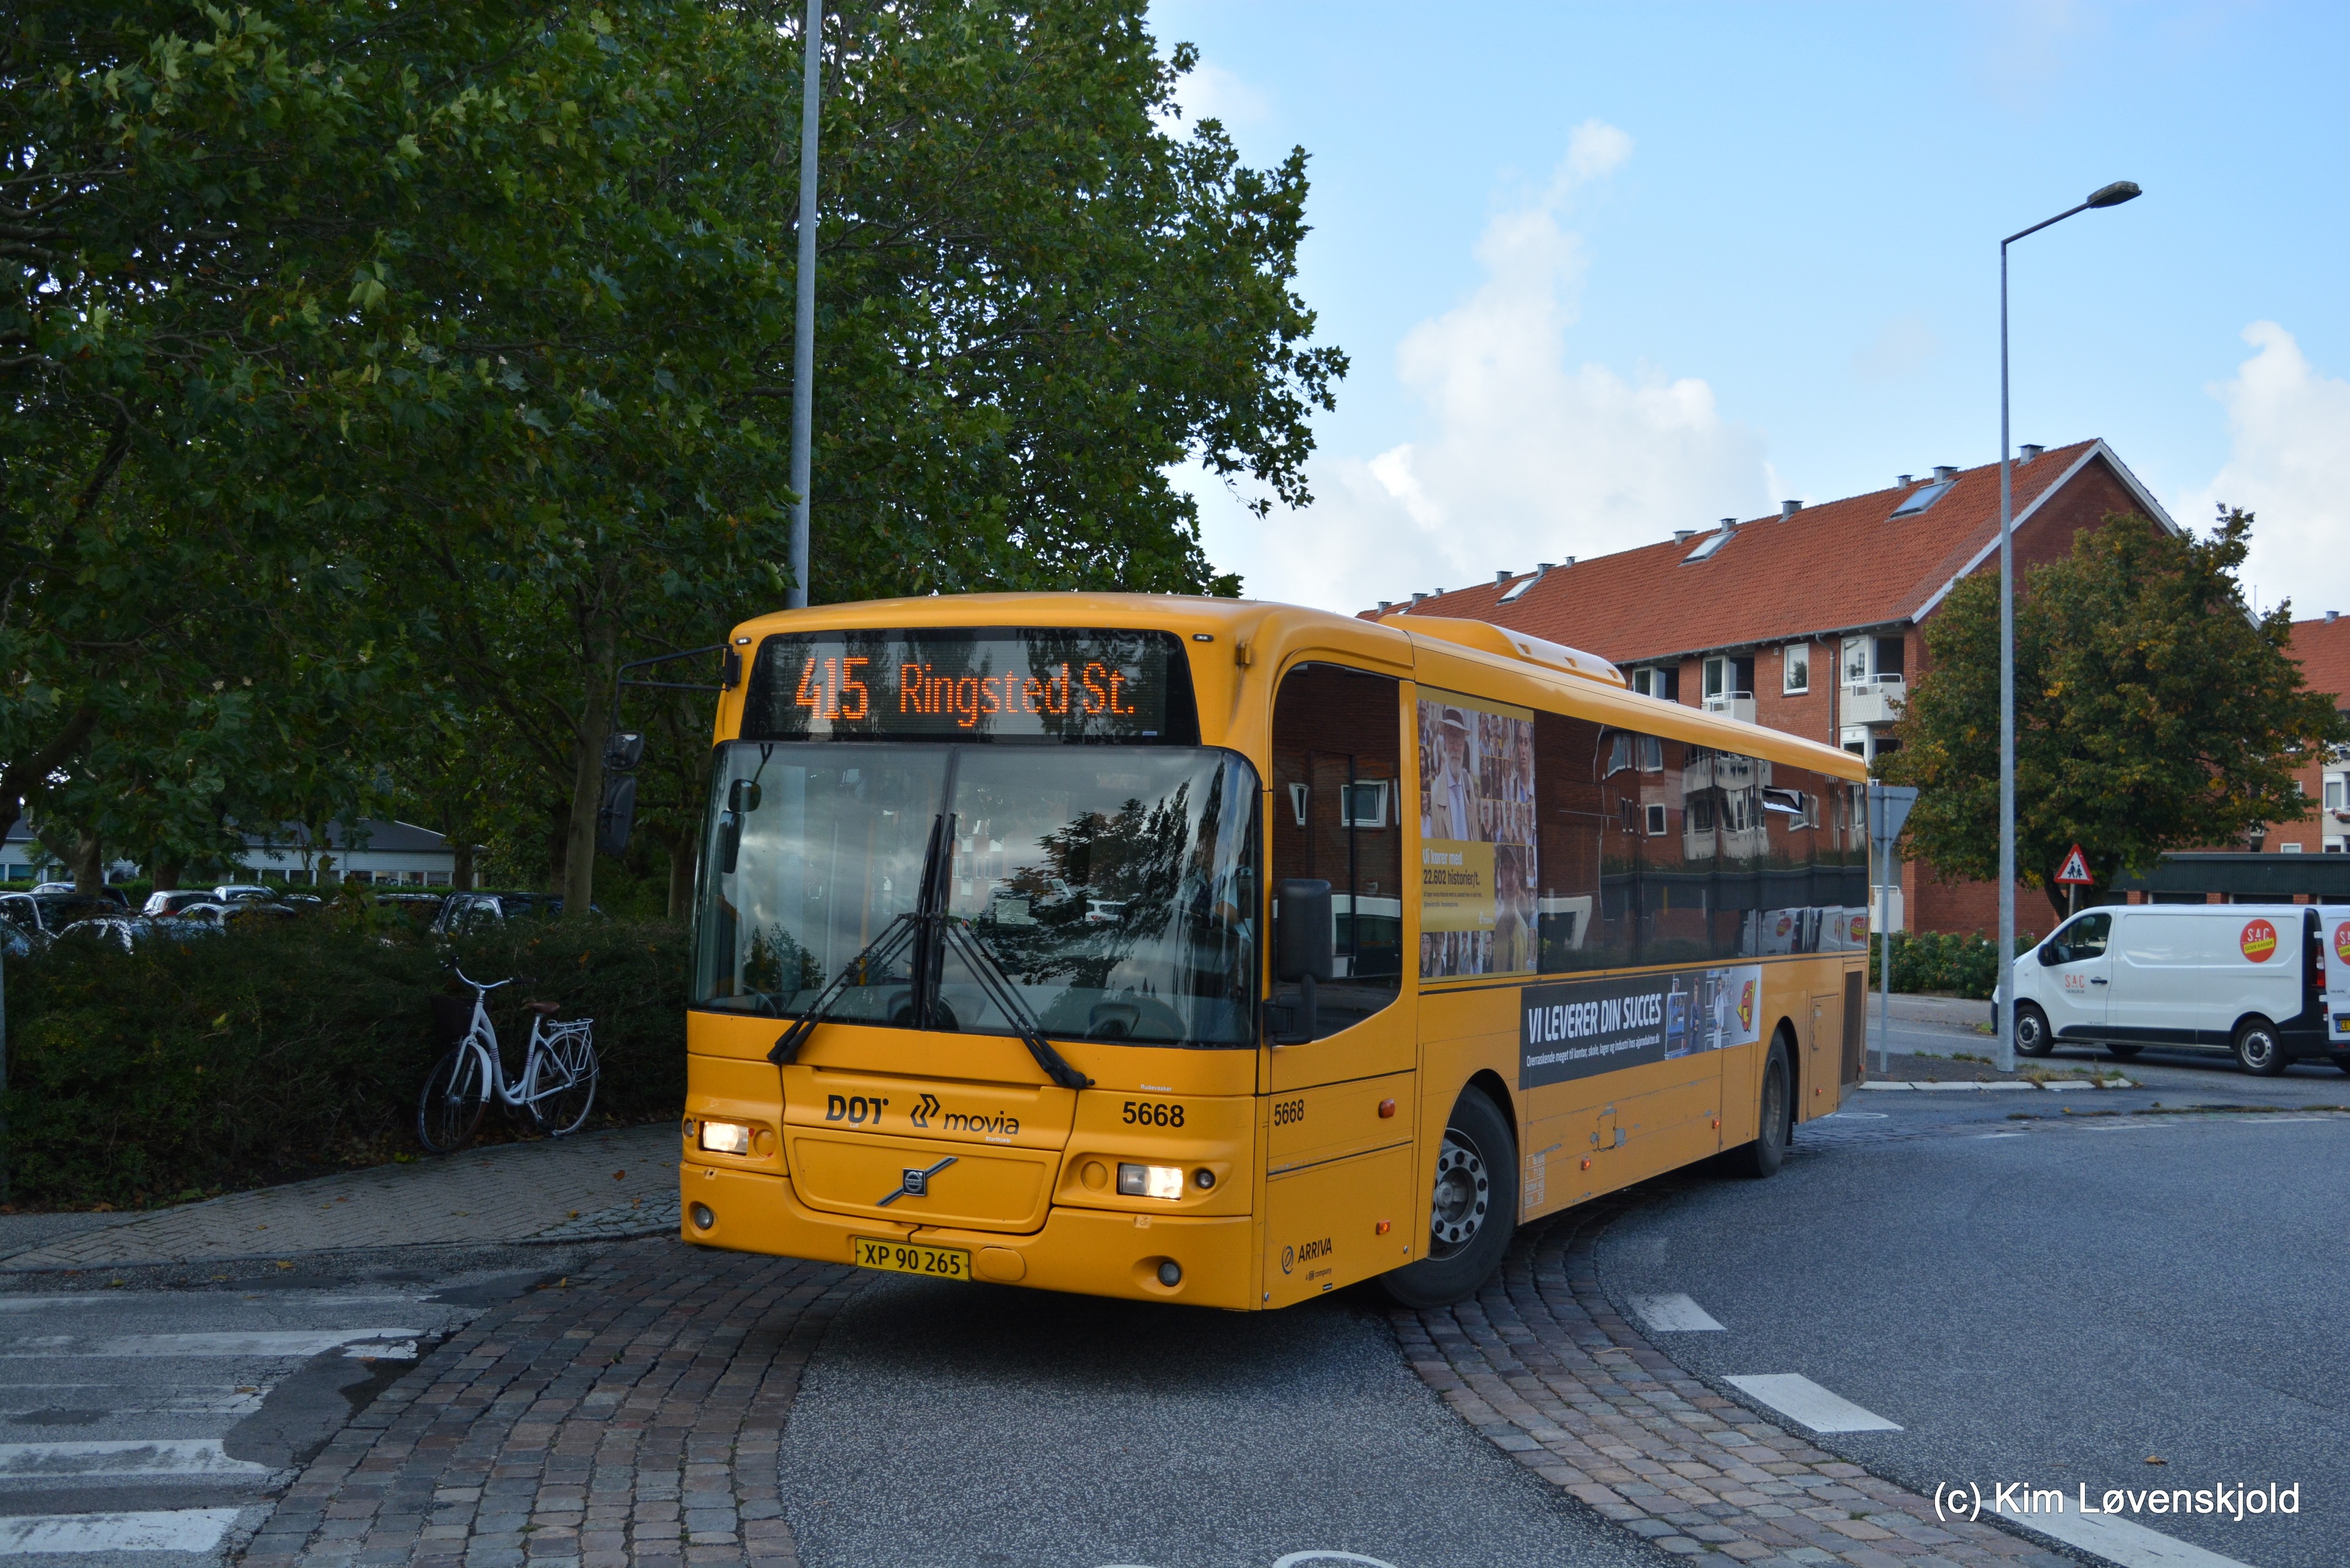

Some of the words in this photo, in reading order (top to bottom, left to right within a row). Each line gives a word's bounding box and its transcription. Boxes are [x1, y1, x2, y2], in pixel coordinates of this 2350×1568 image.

[796, 657, 868, 720] 415
[900, 662, 1069, 727] Ringsted
[1083, 663, 1135, 714] St.
[1431, 849, 1448, 865] kører
[1449, 851, 1463, 866] med
[1423, 869, 1446, 884] 22.602
[1448, 868, 1480, 888] historier/t.
[2247, 928, 2269, 941] SAC
[2065, 974, 2084, 988] SAC
[1529, 1007, 1542, 1044] VI
[1545, 1001, 1598, 1042] LEVERER
[1600, 998, 1621, 1033] DIN
[1623, 993, 1662, 1029] SUCCES
[1526, 1051, 1555, 1067] Overraskende
[1555, 1050, 1569, 1064] meget
[1573, 1047, 1588, 1059] kontor,
[1588, 1045, 1599, 1057] skole,
[1599, 1043, 1609, 1056] lager
[1610, 1043, 1615, 1053] og
[1614, 1039, 1629, 1051] industri
[1635, 1033, 1660, 1050] ajprodukter.dk
[825, 1094, 882, 1125] DOT
[943, 1110, 1020, 1135] movia
[1122, 1101, 1185, 1128] 5668
[1274, 1099, 1304, 1127] 5668
[865, 1244, 890, 1265] XP
[895, 1248, 919, 1270] 90
[925, 1252, 961, 1275] 265
[1298, 1238, 1332, 1263] ARRIVA
[1315, 1267, 1332, 1278] company
